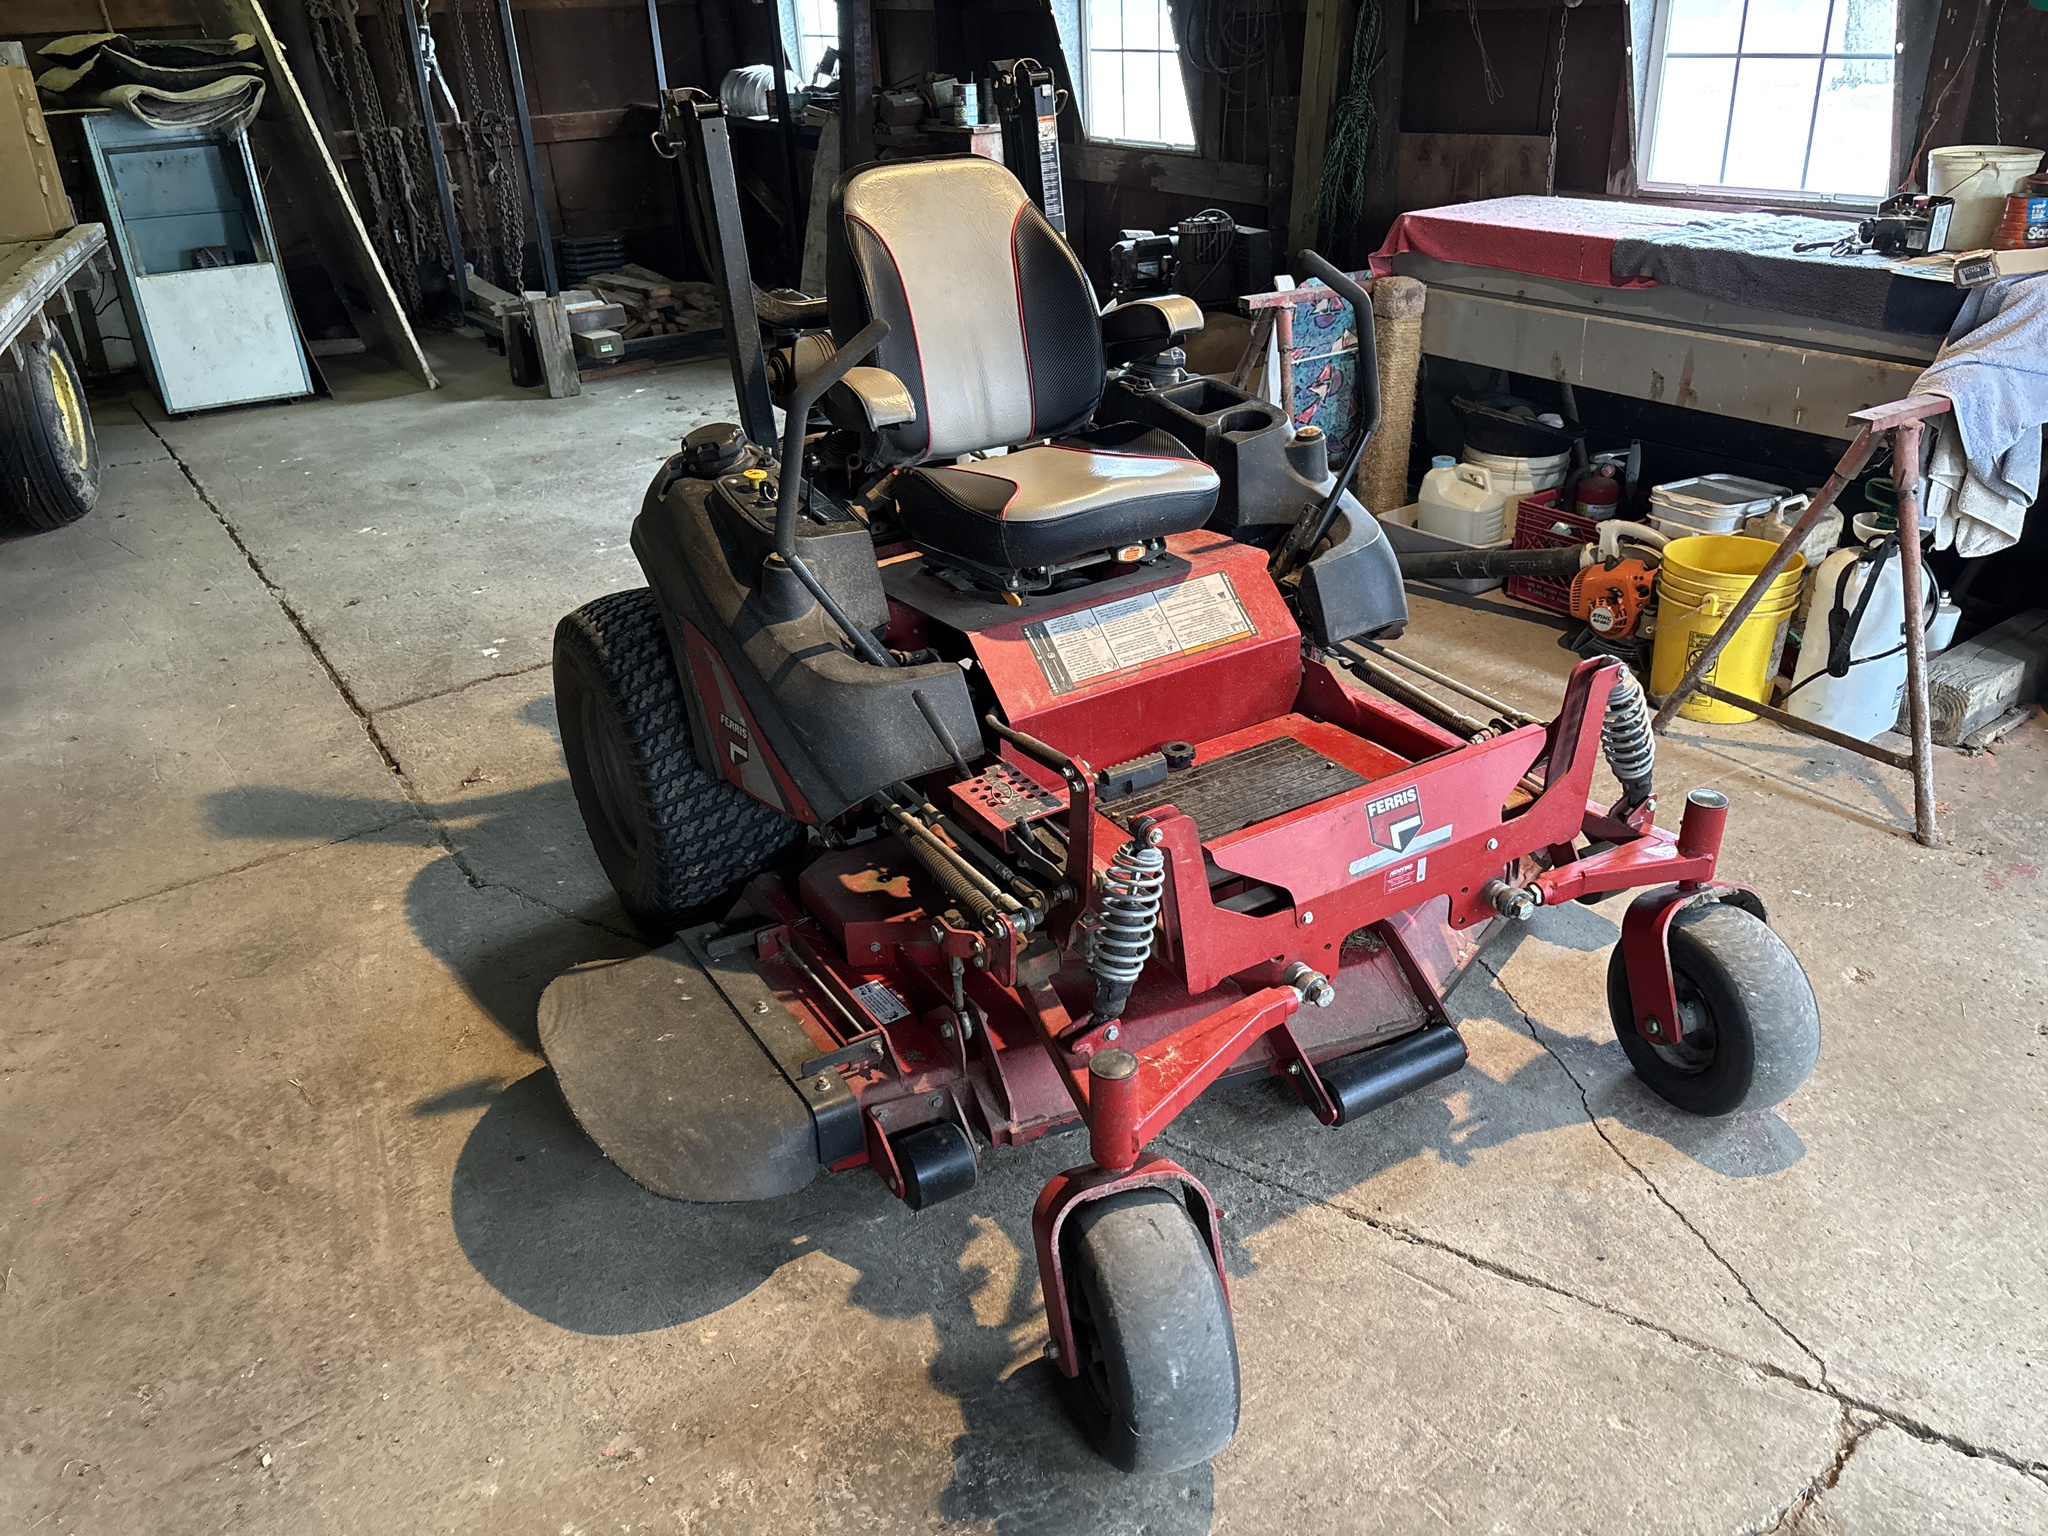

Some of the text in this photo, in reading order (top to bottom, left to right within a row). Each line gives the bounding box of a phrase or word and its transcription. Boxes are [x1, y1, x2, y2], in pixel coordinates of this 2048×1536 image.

[1592, 612, 1612, 623] STIHL
[720, 713, 748, 739] FERRIS
[1368, 789, 1417, 817] FERRIS
